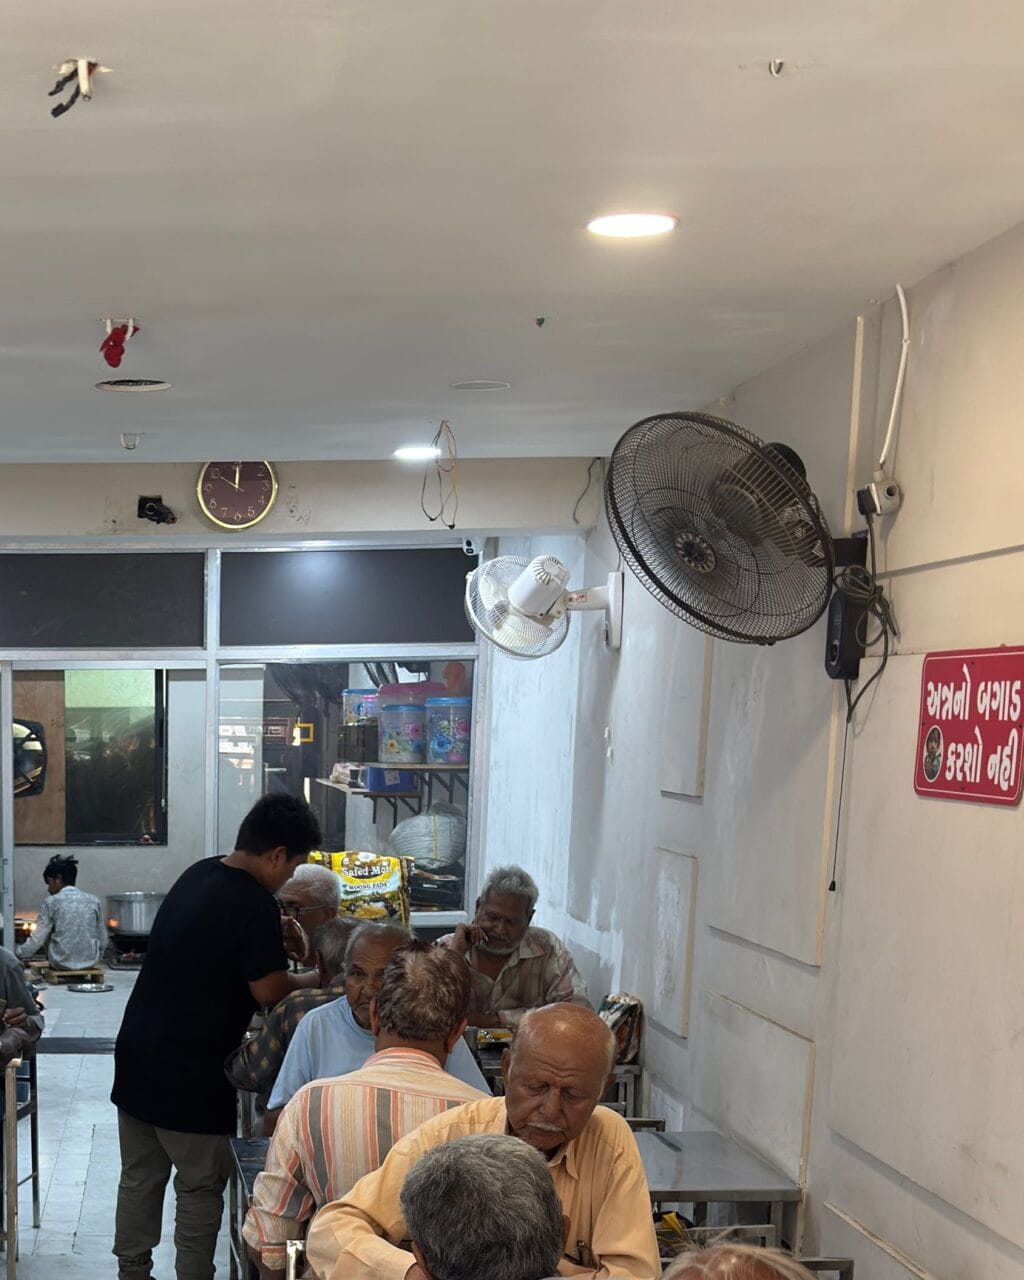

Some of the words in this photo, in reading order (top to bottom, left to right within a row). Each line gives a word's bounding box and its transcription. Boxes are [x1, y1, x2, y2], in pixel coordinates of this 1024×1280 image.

[927, 664, 971, 720] અન્નનો
[977, 680, 1021, 721] બગાડ
[945, 725, 983, 783] કરશો
[987, 728, 1018, 791] નહી
[342, 866, 368, 876] Safed
